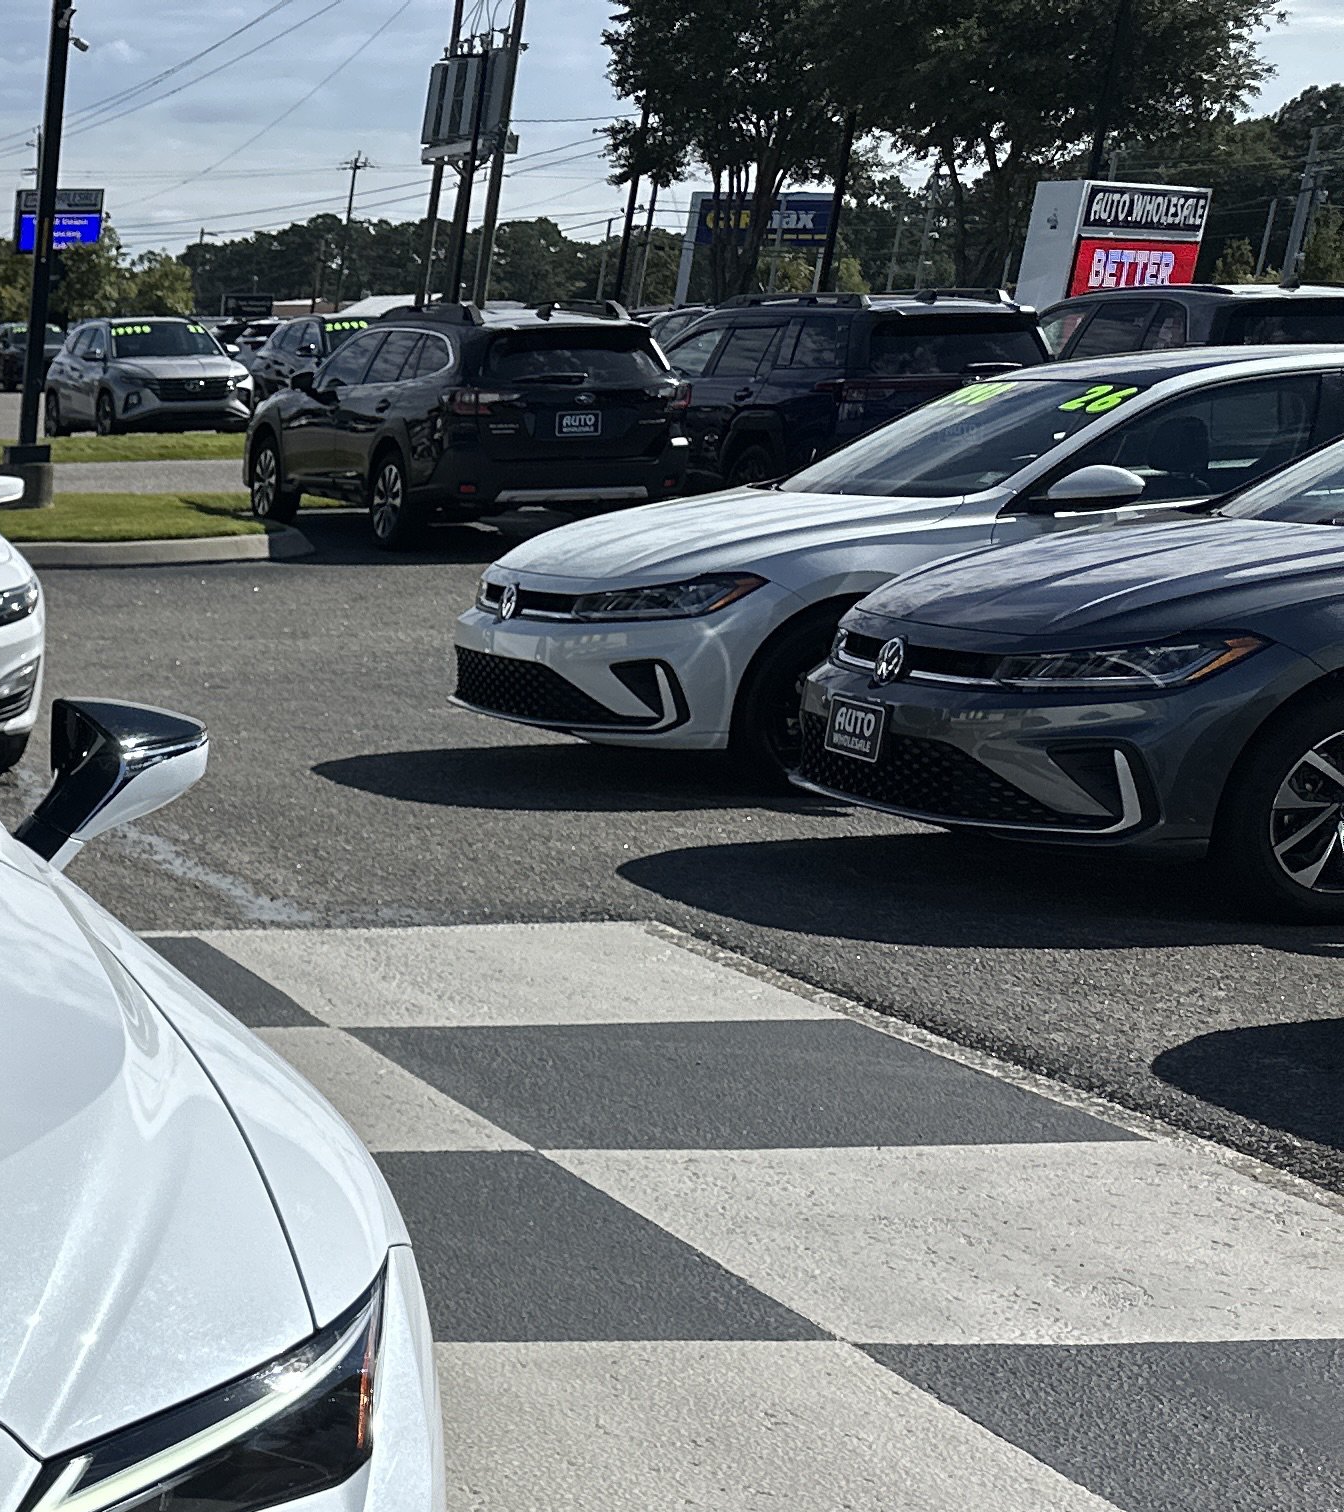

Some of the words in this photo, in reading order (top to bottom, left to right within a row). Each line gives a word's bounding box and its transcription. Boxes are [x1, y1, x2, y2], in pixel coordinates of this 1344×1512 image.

[1090, 191, 1130, 223] AUTO
[1131, 193, 1206, 226] WHOLESALE
[1088, 248, 1175, 288] BETTER
[1058, 385, 1138, 414] 26
[562, 414, 596, 427] AUTO
[835, 707, 876, 737] AUTO
